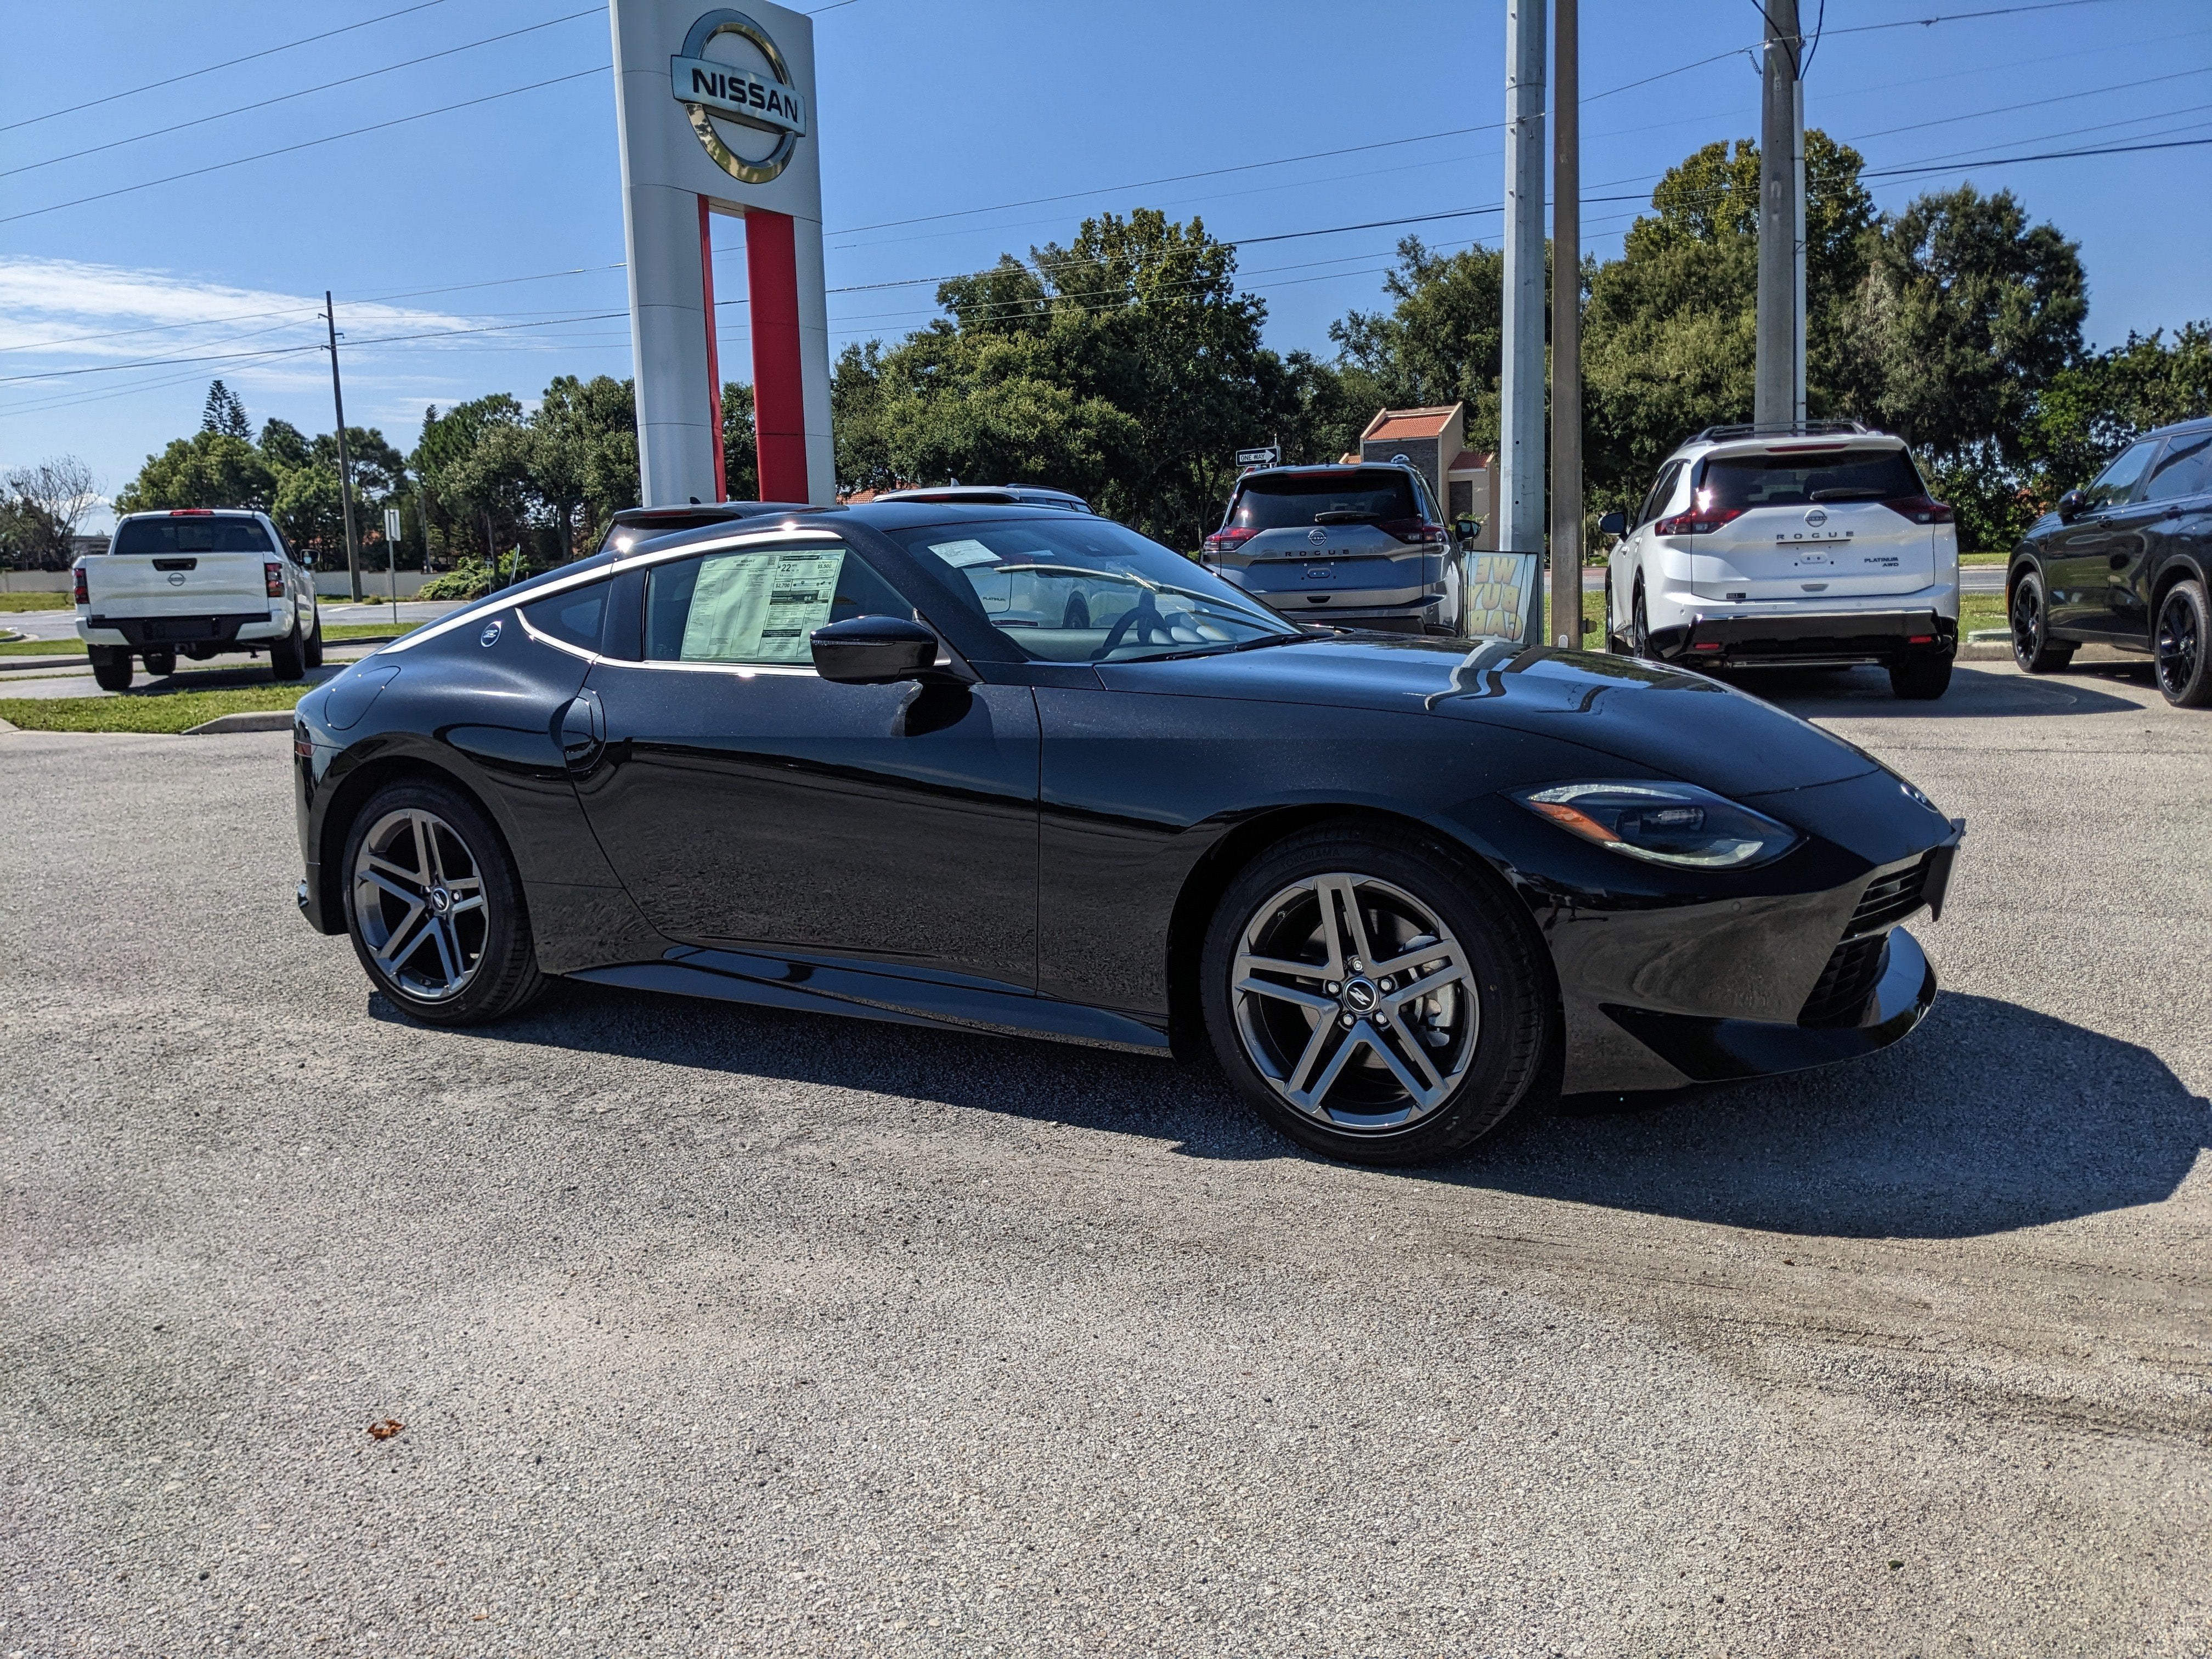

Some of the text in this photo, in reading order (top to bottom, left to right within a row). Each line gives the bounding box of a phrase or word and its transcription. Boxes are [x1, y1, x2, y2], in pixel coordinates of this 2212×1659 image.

[692, 68, 798, 123] NISSAN
[1776, 531, 1854, 540] ROGUE
[1282, 848, 1339, 868] YOKOHAMA
